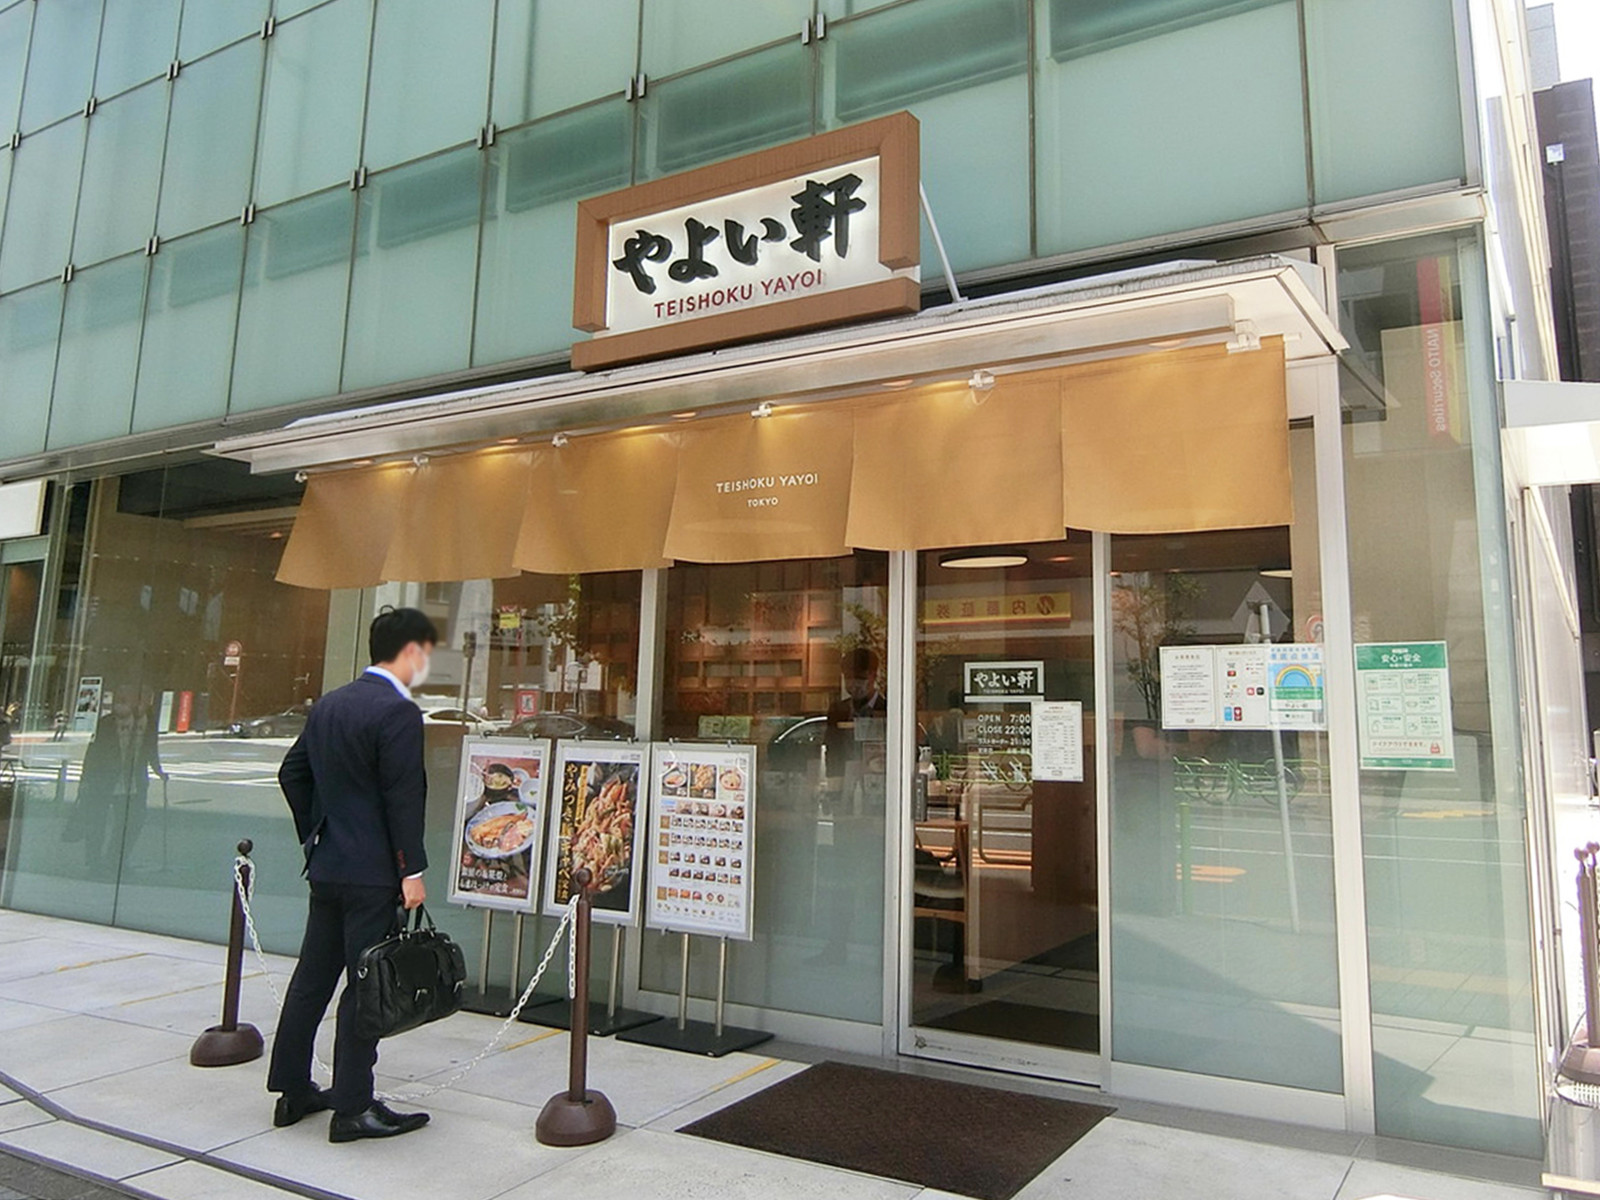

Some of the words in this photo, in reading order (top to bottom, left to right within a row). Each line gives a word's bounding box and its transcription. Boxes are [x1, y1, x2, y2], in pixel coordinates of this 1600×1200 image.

[613, 173, 867, 295] やよい軒
[654, 283, 753, 318] TEISHOKU
[762, 269, 822, 296] YAYOI
[716, 477, 774, 493] TEISHOKU
[779, 473, 818, 486] YAYOI
[747, 497, 779, 507] TOKYO
[973, 670, 1034, 689] やよい軒
[977, 714, 1001, 722] OPEN
[1009, 714, 1031, 723] 7:00
[977, 725, 1003, 734] CLOSE
[1005, 725, 1031, 735] 22:00
